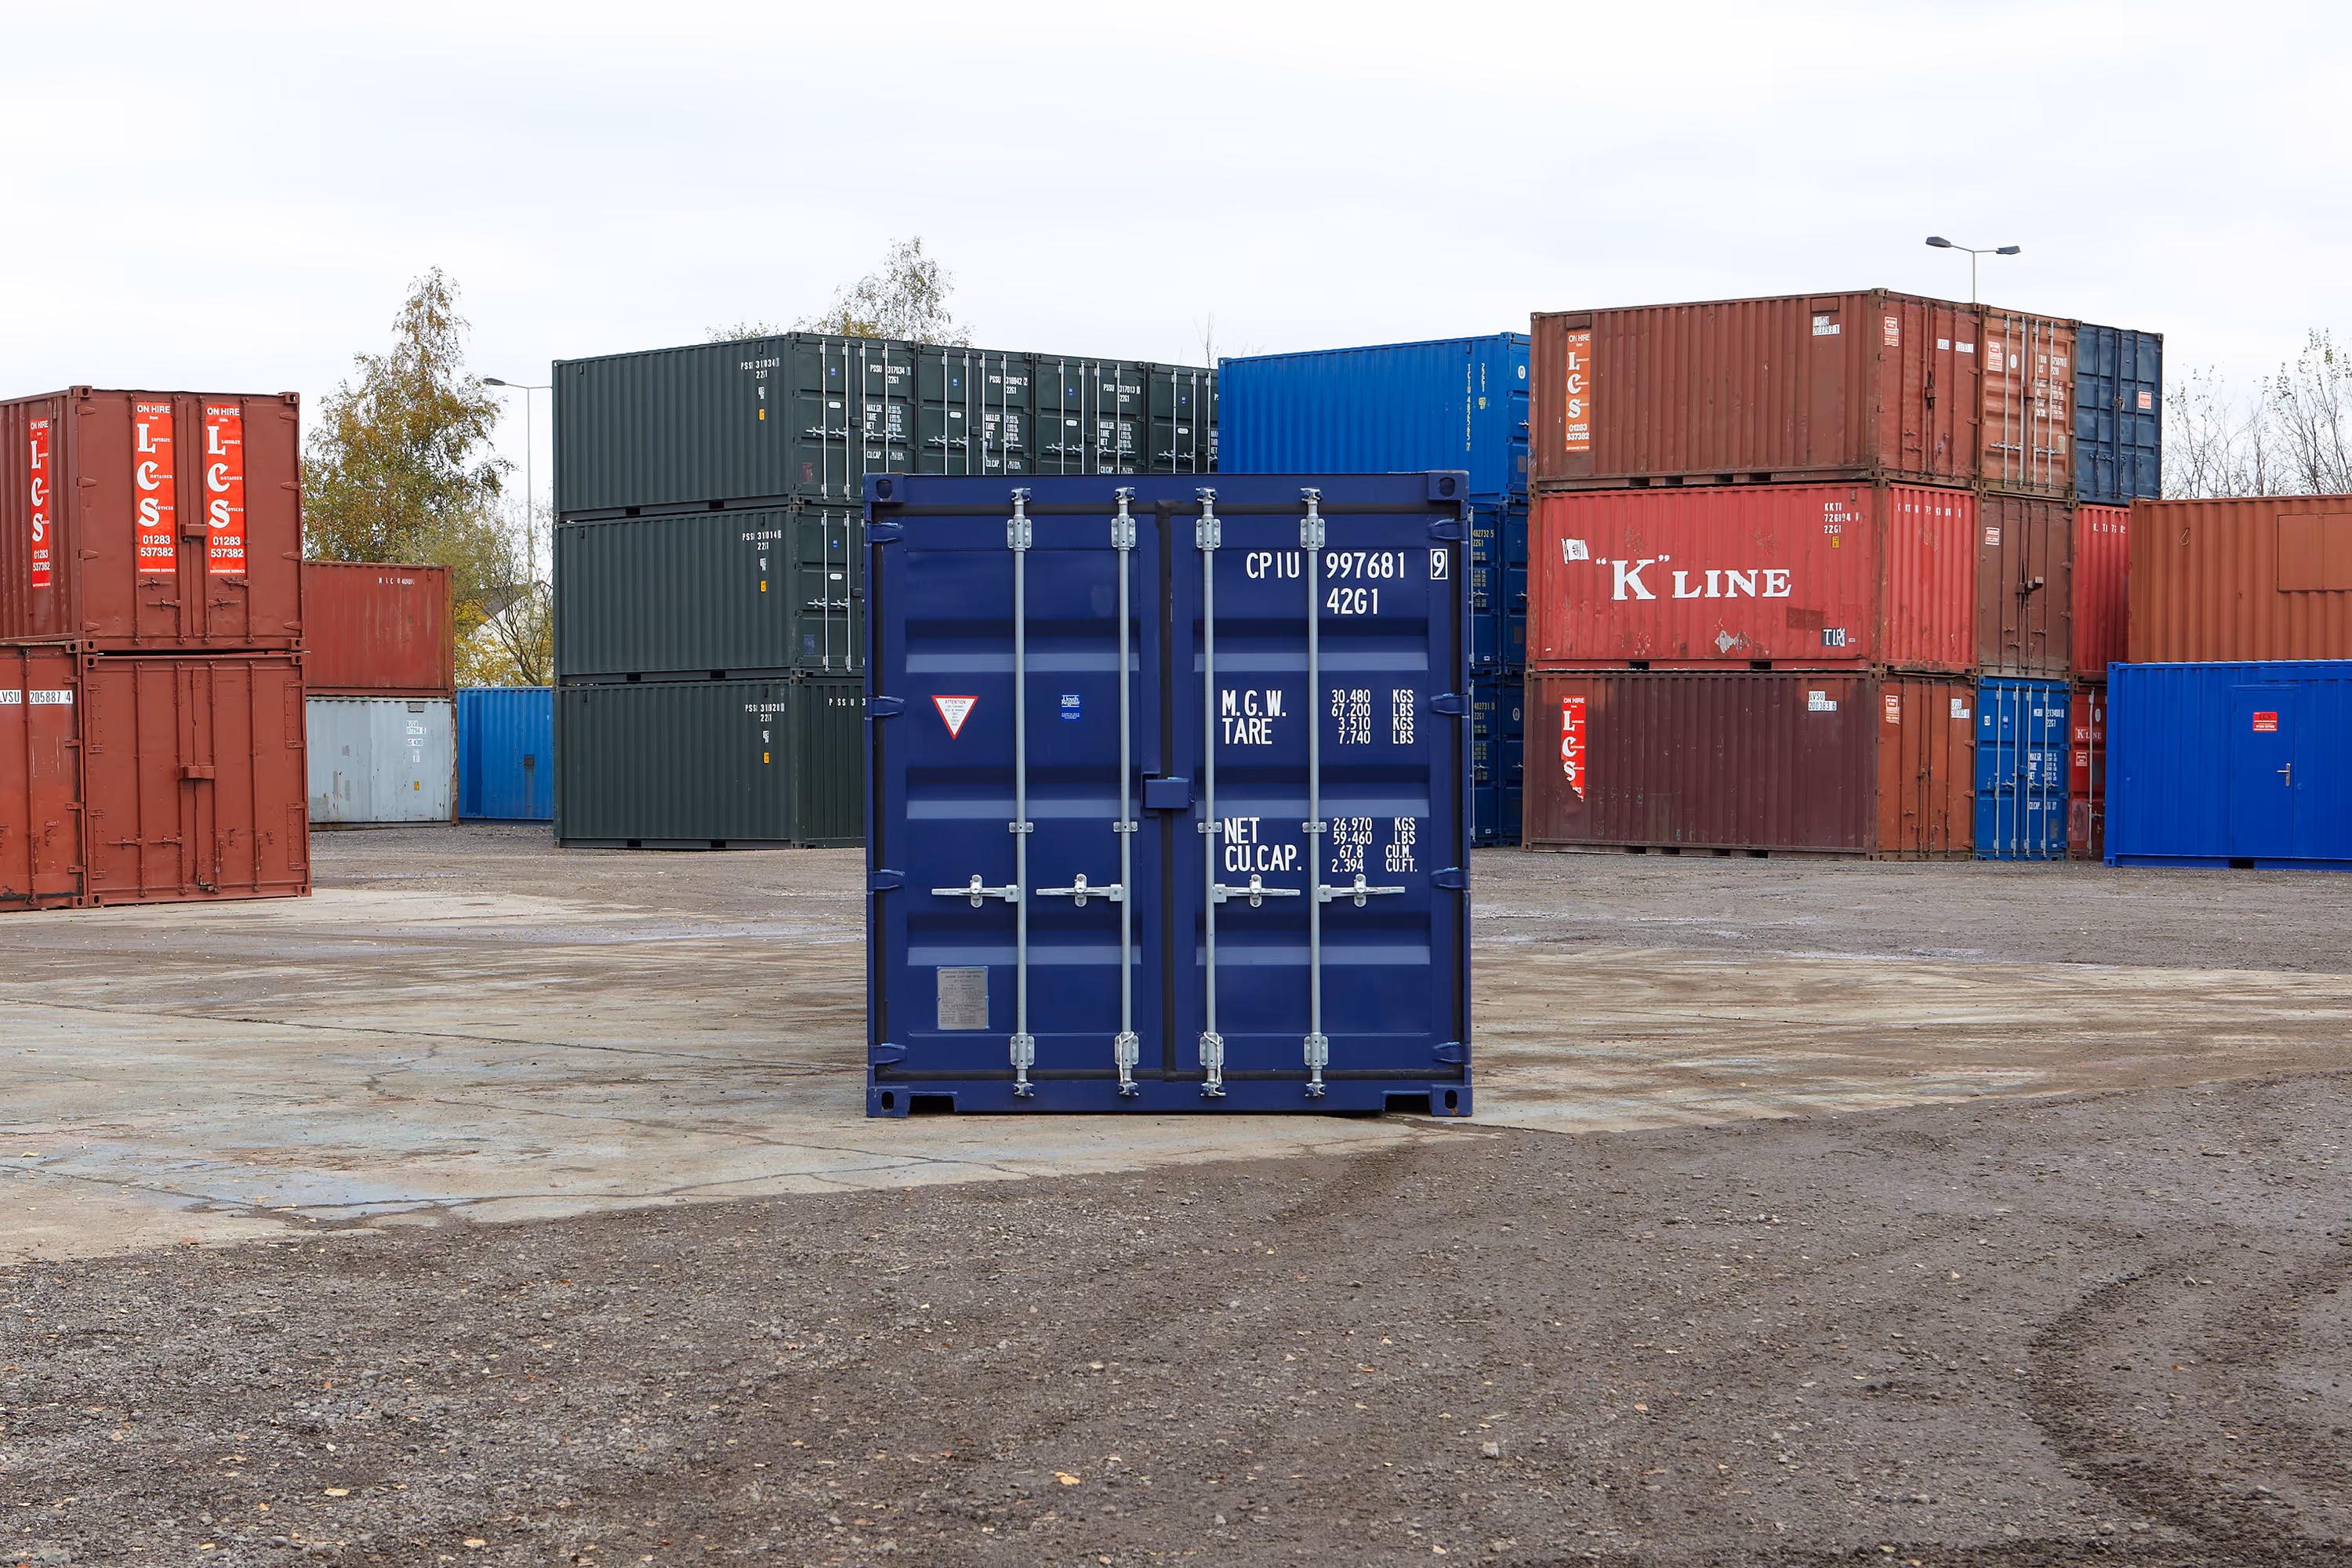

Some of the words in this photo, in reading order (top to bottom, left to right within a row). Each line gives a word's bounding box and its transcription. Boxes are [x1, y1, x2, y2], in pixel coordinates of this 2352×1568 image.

[869, 364, 883, 373] PSSU
[989, 375, 1002, 384] PSSU
[1102, 383, 1115, 392] PSSU
[136, 405, 150, 413] ON
[151, 405, 171, 414] HIRE
[206, 407, 220, 416] ON
[220, 407, 241, 416] HIRE
[30, 421, 38, 430] ON
[38, 419, 49, 430] HIRE
[1566, 432, 1590, 441] 537382
[142, 535, 171, 545] 01283
[212, 535, 241, 546] 01283
[140, 546, 174, 557] 537382
[210, 548, 244, 558] 537382
[1246, 551, 1301, 579] CPIU
[1325, 551, 1405, 579] 997681
[1431, 550, 1446, 579] 9
[1671, 568, 1792, 599] LINE
[1326, 587, 1379, 615] 42G1
[30, 691, 61, 703] 205887
[66, 691, 71, 702] 4
[1809, 692, 1824, 701] LVSU
[1221, 689, 1287, 717] M.G.W.
[1330, 689, 1371, 703] 30,480
[1392, 689, 1414, 703] KGS
[1809, 702, 1830, 710] 200383
[1330, 702, 1371, 717] 67,200
[1392, 703, 1414, 717] LBS
[1221, 717, 1273, 745] TARE
[1338, 717, 1371, 731] 3,510
[1392, 717, 1414, 731] KGS
[1338, 731, 1371, 745] 7,740
[1392, 731, 1414, 745] LBS
[1223, 816, 1261, 844] NET
[1332, 817, 1373, 832] 26,970
[1393, 817, 1416, 832] KGS
[1393, 831, 1416, 845] LBS
[1224, 844, 1302, 873] CU.CAP.
[1338, 844, 1364, 859] 67.8
[1385, 844, 1413, 859] CU.M.
[1330, 858, 1364, 873] 2,394
[1385, 858, 1418, 873] CU.FT.
